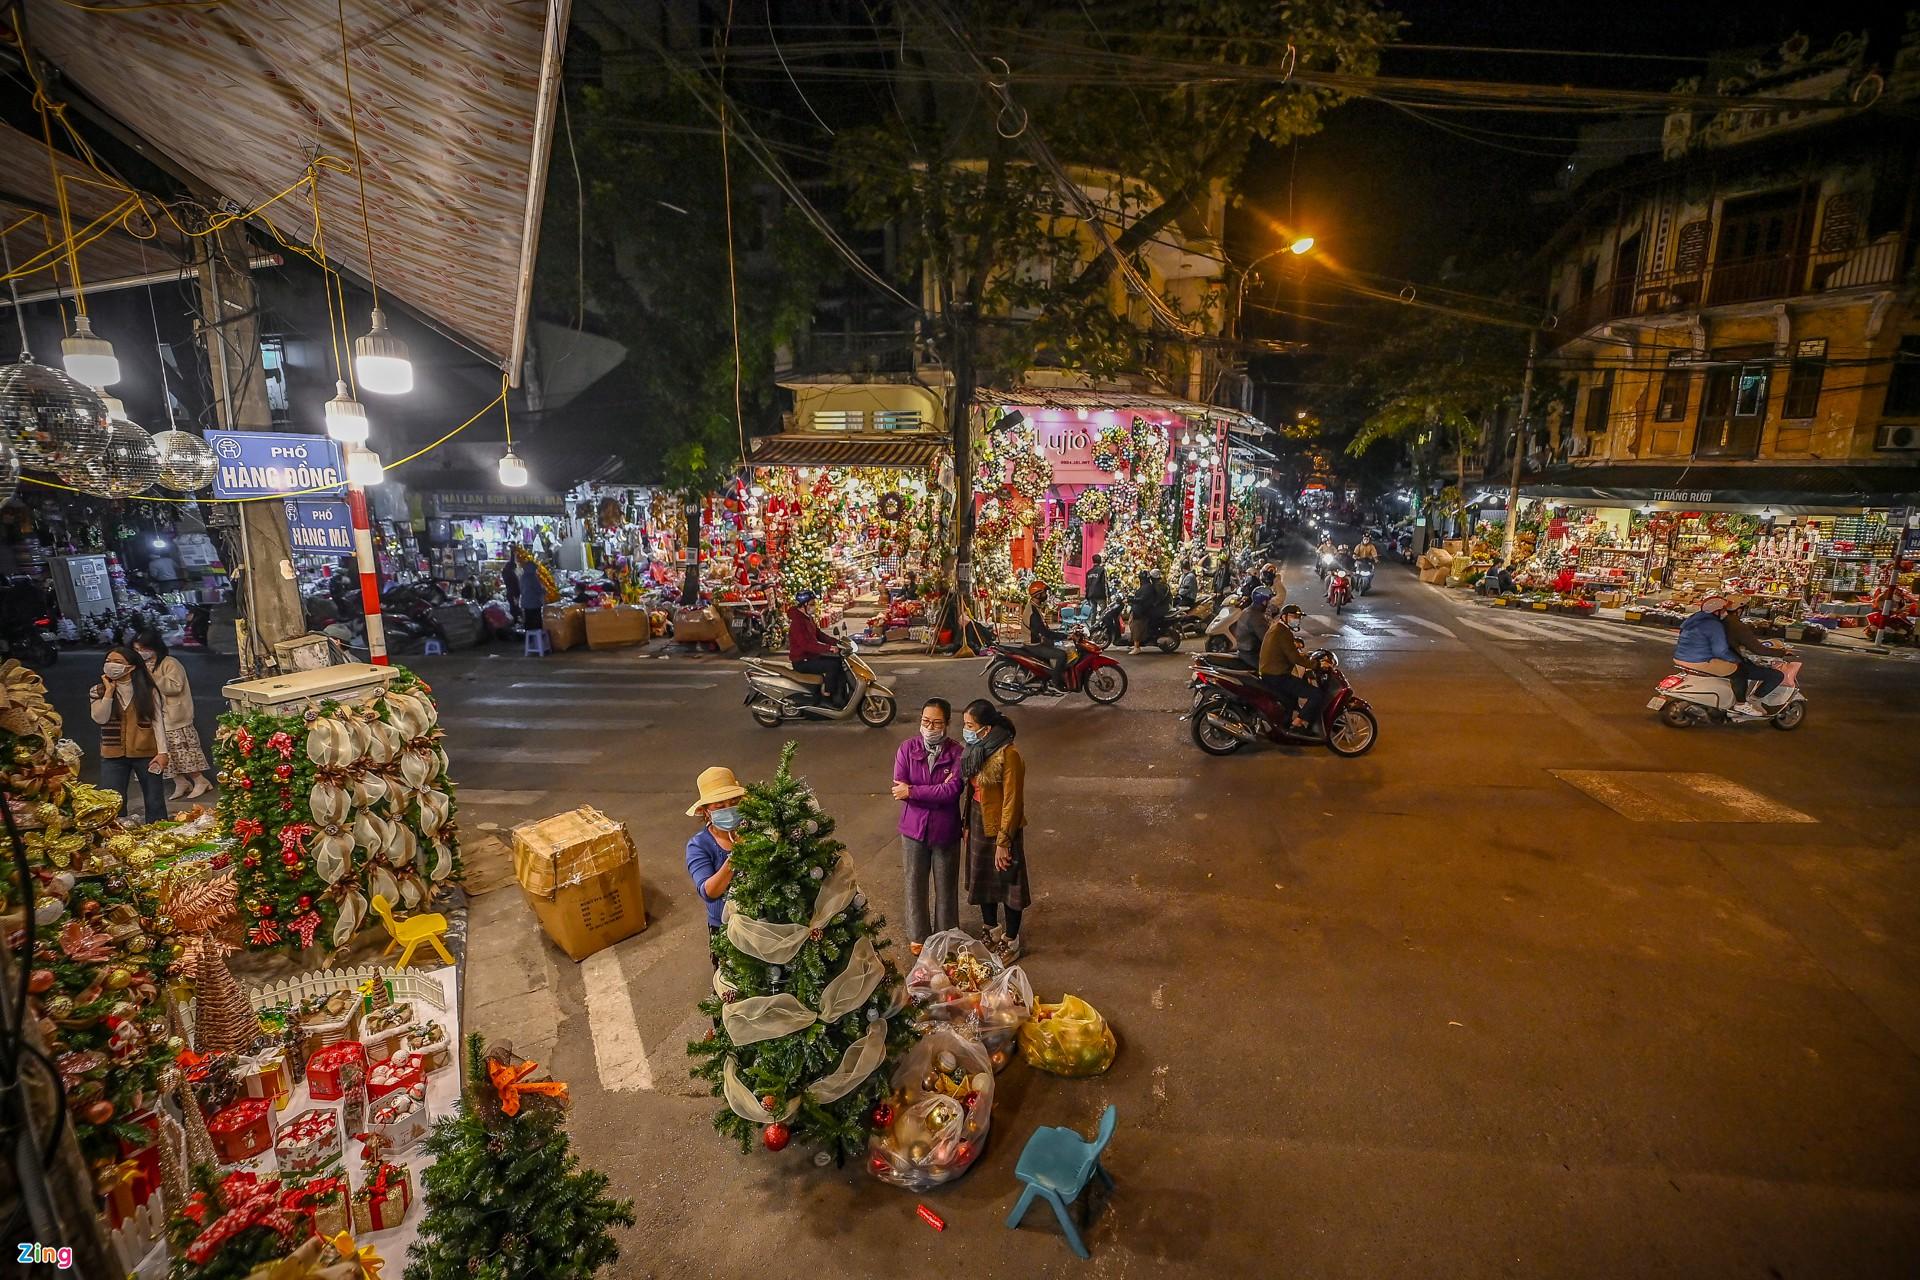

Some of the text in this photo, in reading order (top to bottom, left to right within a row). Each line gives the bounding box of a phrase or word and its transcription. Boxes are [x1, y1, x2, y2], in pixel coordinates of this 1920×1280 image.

[271, 443, 308, 458] PHỐ
[221, 460, 338, 489] HÀNG ĐỒNG
[312, 507, 334, 521] PHỐ
[686, 504, 698, 514] 60
[292, 523, 351, 547] HÀNG MÃ
